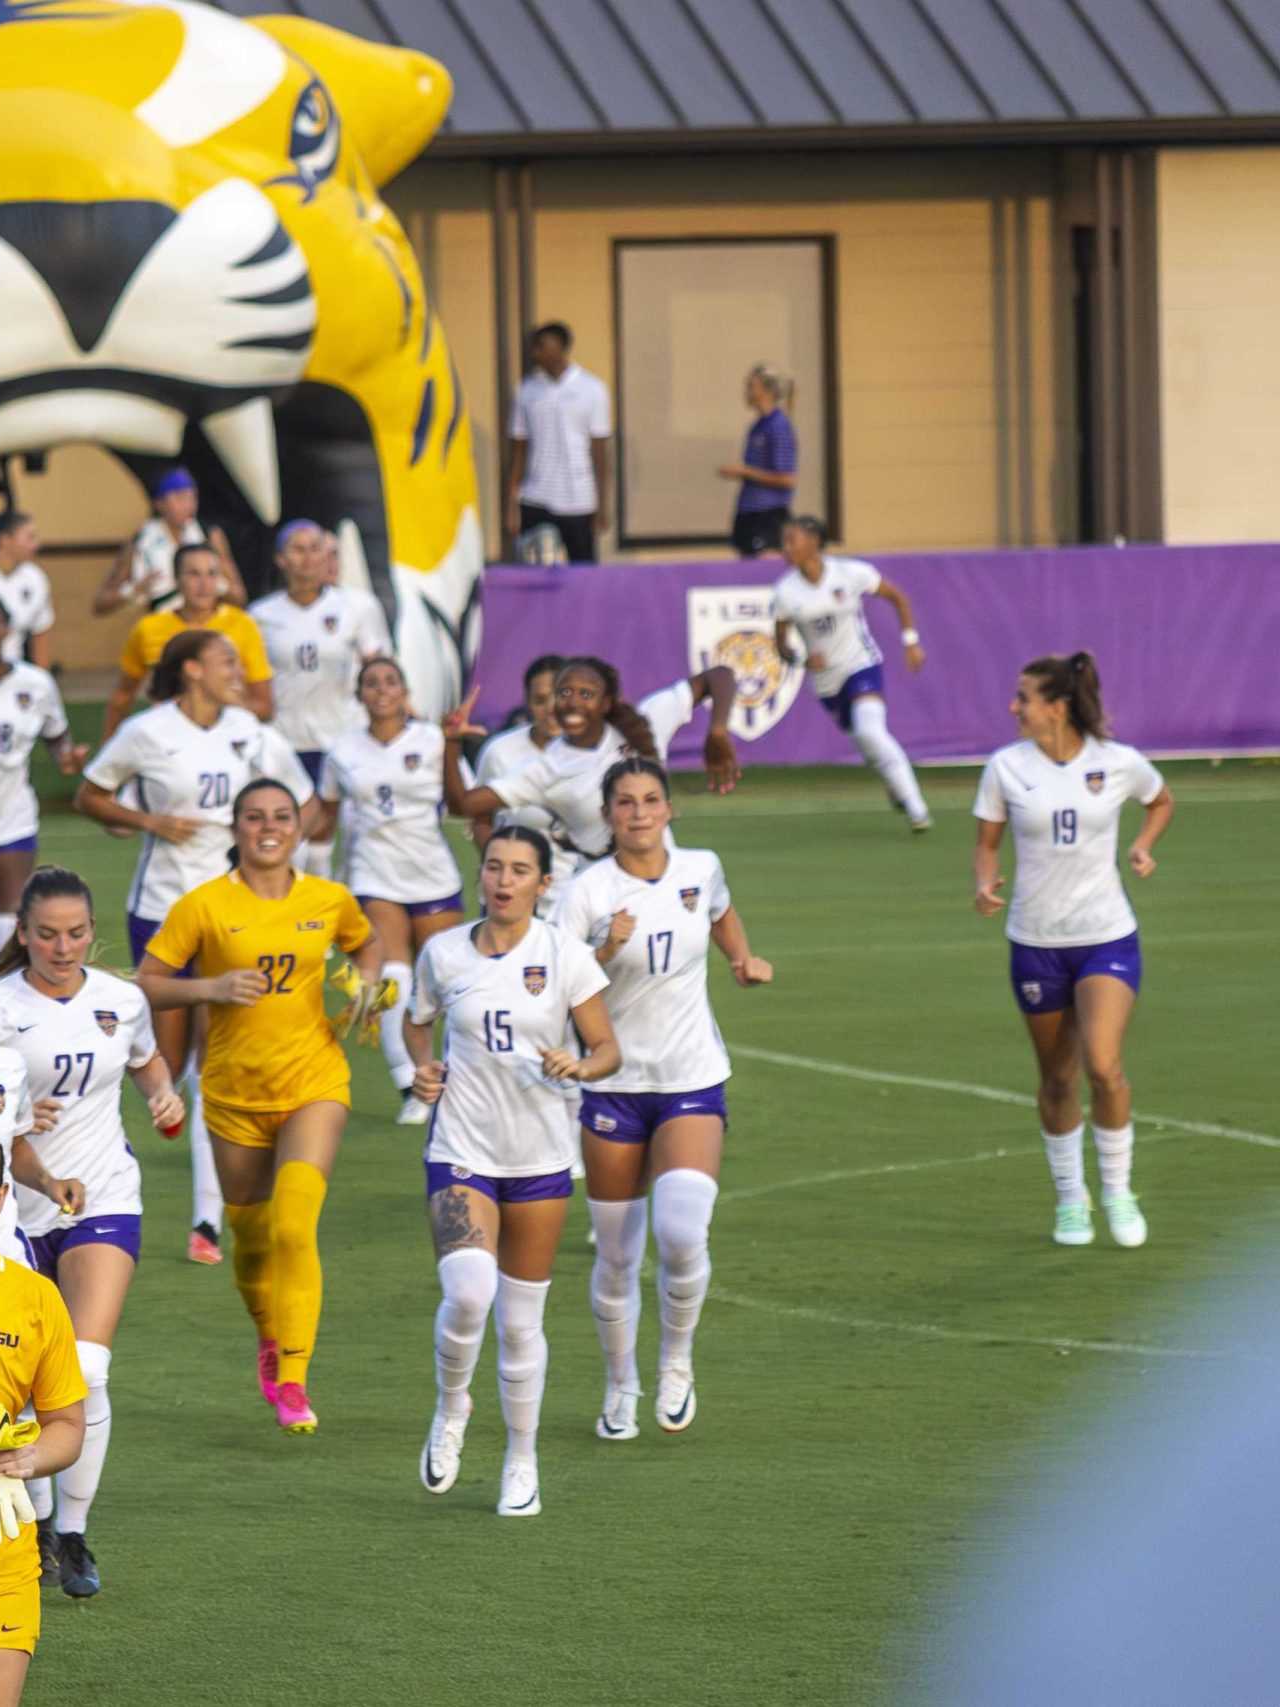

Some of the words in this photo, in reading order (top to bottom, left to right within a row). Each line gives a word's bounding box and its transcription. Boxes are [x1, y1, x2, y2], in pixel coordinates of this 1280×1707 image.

[199, 773, 230, 809] 20
[1052, 809, 1077, 845] 19
[647, 931, 673, 975] 17
[258, 954, 296, 993] 32
[484, 1010, 514, 1052] 15
[52, 1053, 95, 1097] 27
